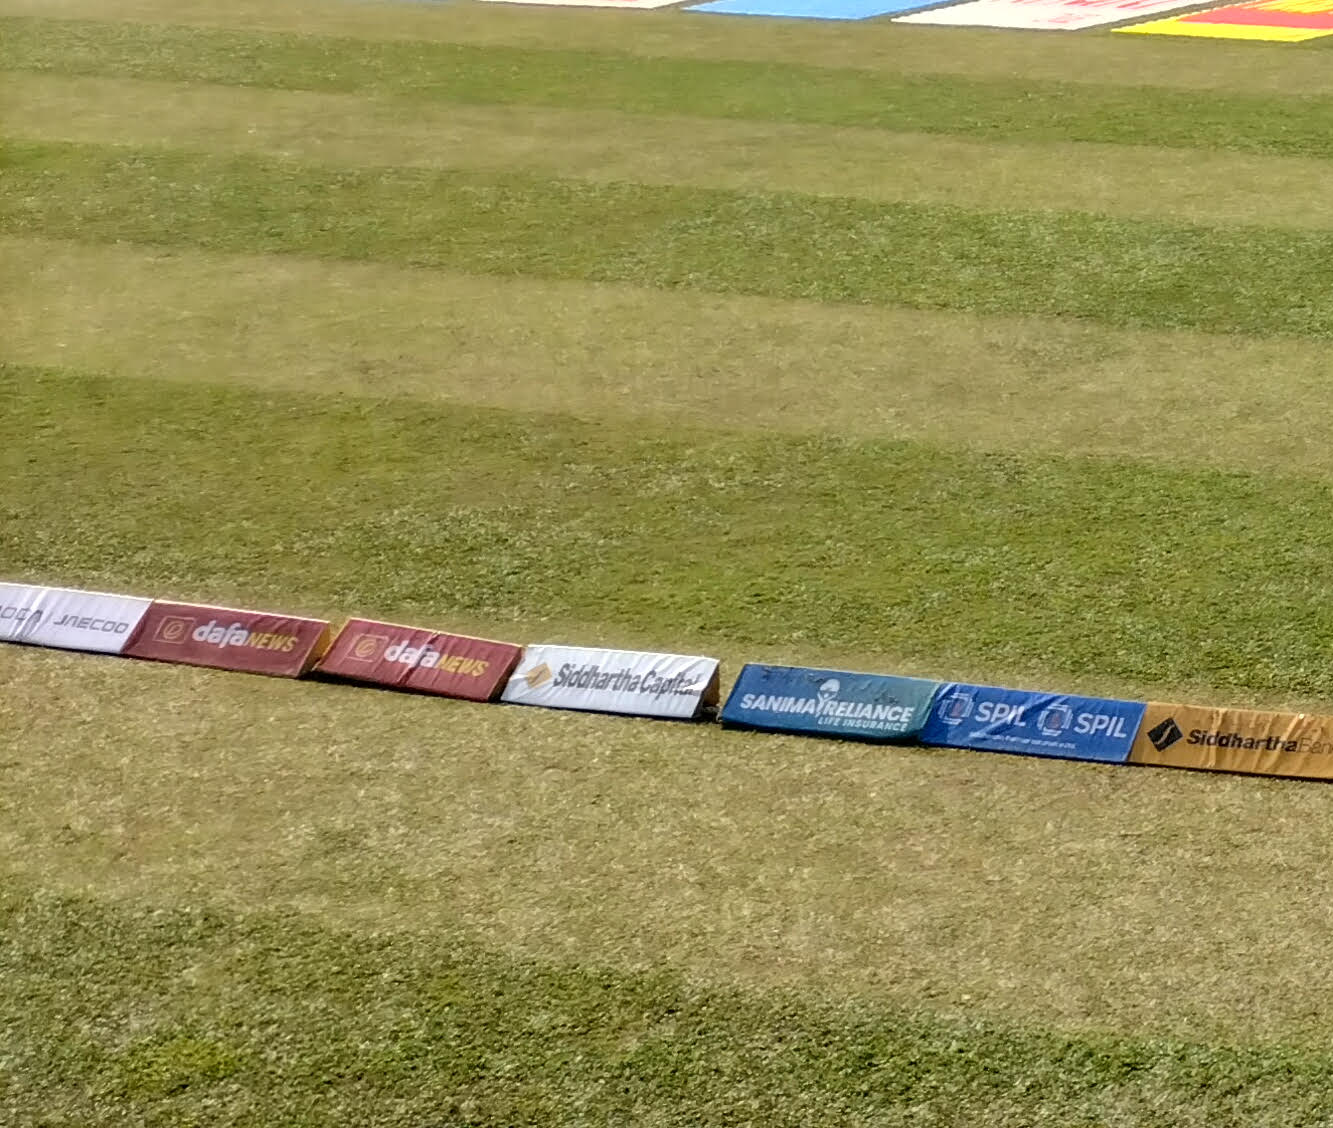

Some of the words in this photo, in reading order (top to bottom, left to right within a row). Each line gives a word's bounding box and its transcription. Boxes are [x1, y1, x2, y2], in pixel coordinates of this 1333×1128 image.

[54, 614, 130, 634] JAECOO
[192, 618, 300, 653] dafaNEWS
[383, 639, 489, 677] dafaNEWS
[553, 662, 640, 693] Siddhartha
[740, 692, 817, 716] SANIMA
[822, 698, 915, 723] RELIANCE
[974, 700, 1027, 728] SPIL
[817, 715, 842, 727] LIFE
[843, 717, 908, 732] INSURANCE
[1072, 713, 1127, 739] SPIL
